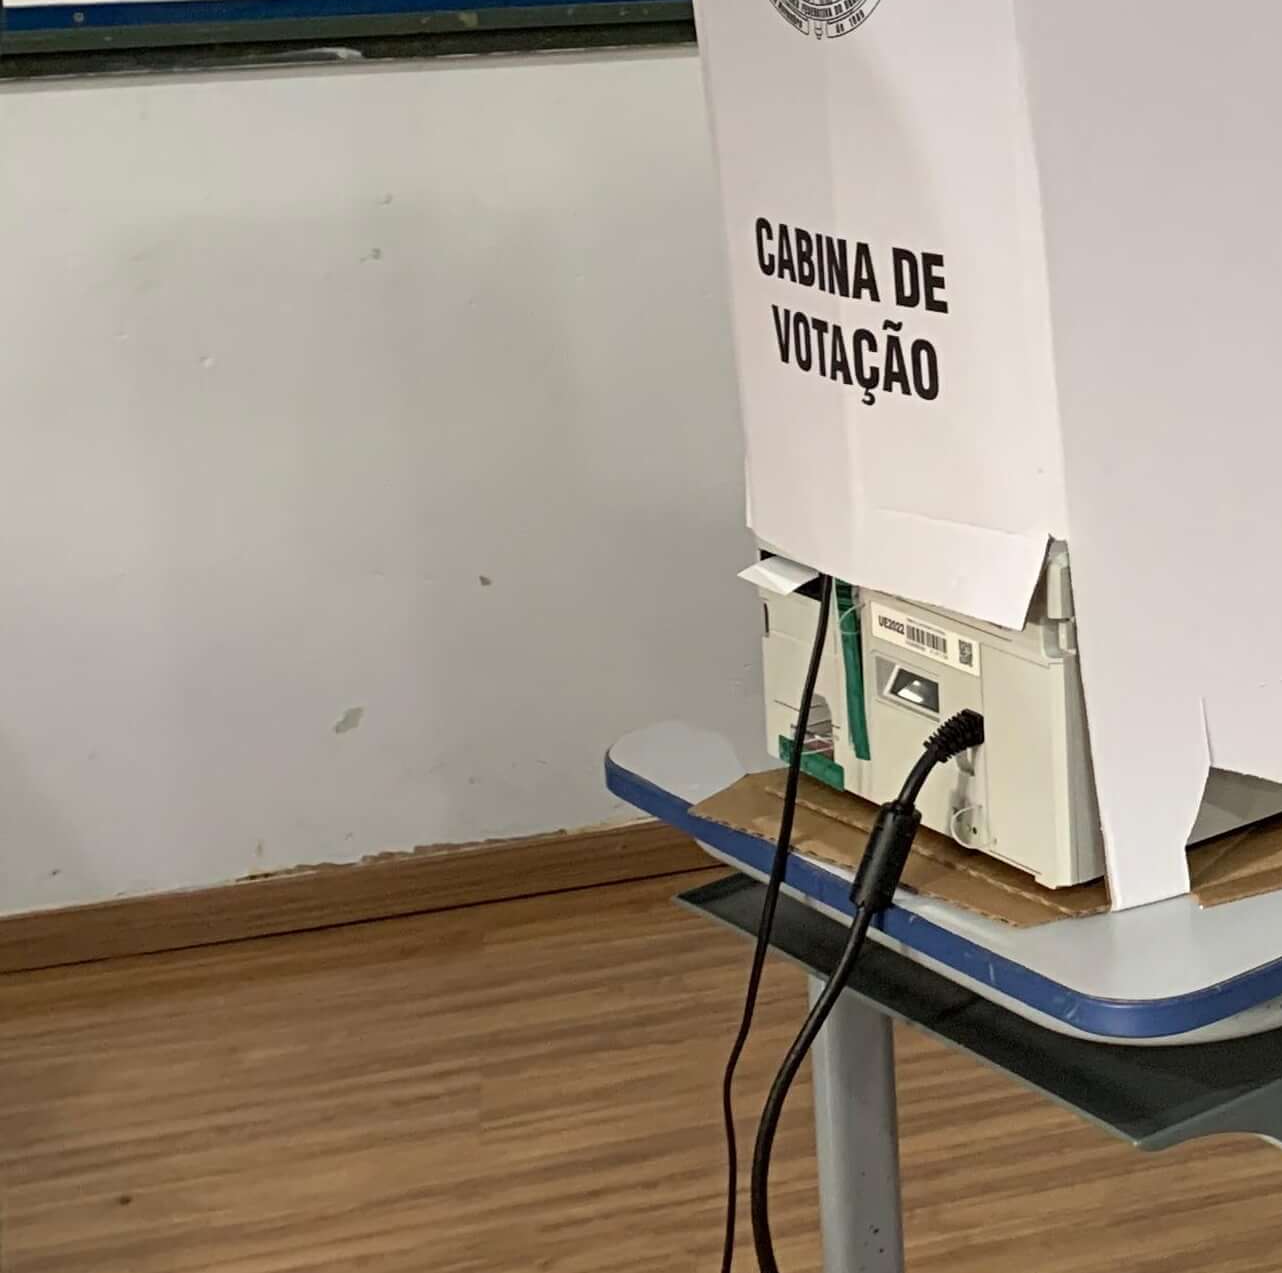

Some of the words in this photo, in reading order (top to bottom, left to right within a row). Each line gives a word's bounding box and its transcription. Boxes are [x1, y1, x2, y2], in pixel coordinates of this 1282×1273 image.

[755, 217, 880, 303] CABINA
[892, 247, 948, 314] DE
[771, 304, 940, 406] VOTAÇÃO
